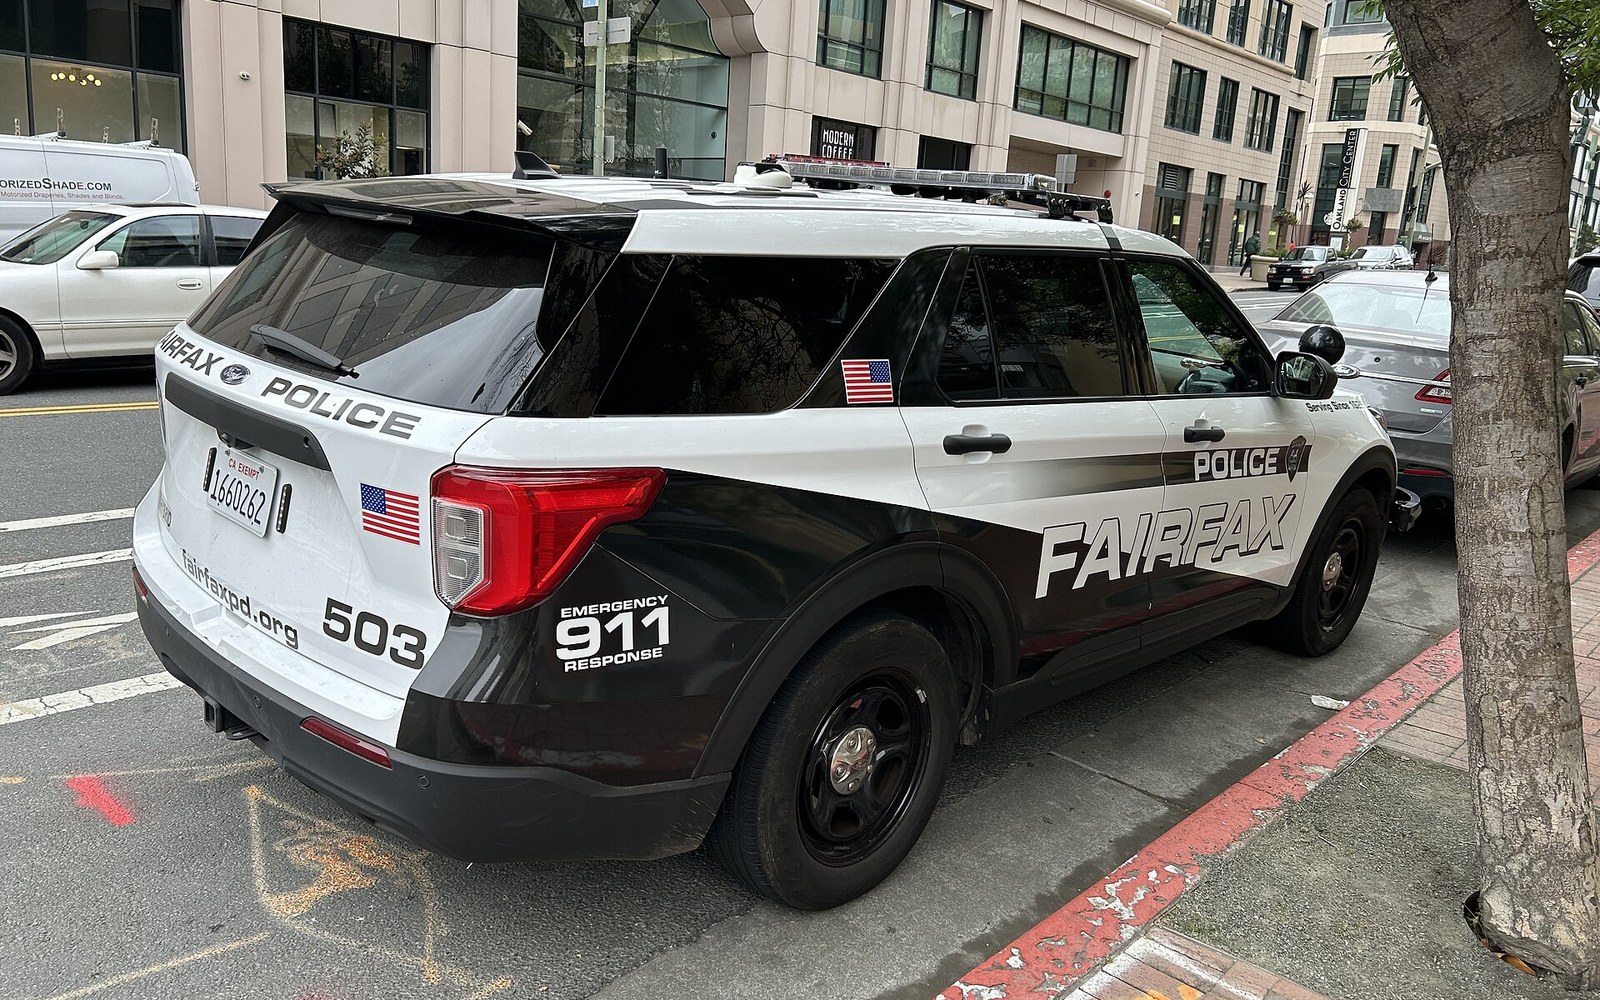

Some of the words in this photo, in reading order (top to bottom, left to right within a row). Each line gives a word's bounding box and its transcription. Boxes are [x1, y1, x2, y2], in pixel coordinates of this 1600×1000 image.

[823, 129, 854, 147] MODERN
[1343, 130, 1357, 164] CENTER
[1339, 167, 1350, 187] CITY
[1, 191, 33, 199] Motorized
[1332, 189, 1347, 230] OAKLAND
[261, 376, 422, 440] POLICE
[1305, 402, 1334, 413] Serving
[1331, 401, 1351, 411] Since
[228, 458, 236, 470] CA
[238, 462, 260, 480] EXEMPT
[1193, 447, 1281, 482] POLICE
[210, 469, 266, 525] 1660262
[1035, 493, 1297, 600] FAIRFAX
[181, 549, 299, 650] fairfaxpd.org
[560, 594, 669, 618] EMERGENCY
[322, 597, 427, 670] 503
[556, 606, 669, 660] 911
[564, 647, 663, 673] RESPONSE
